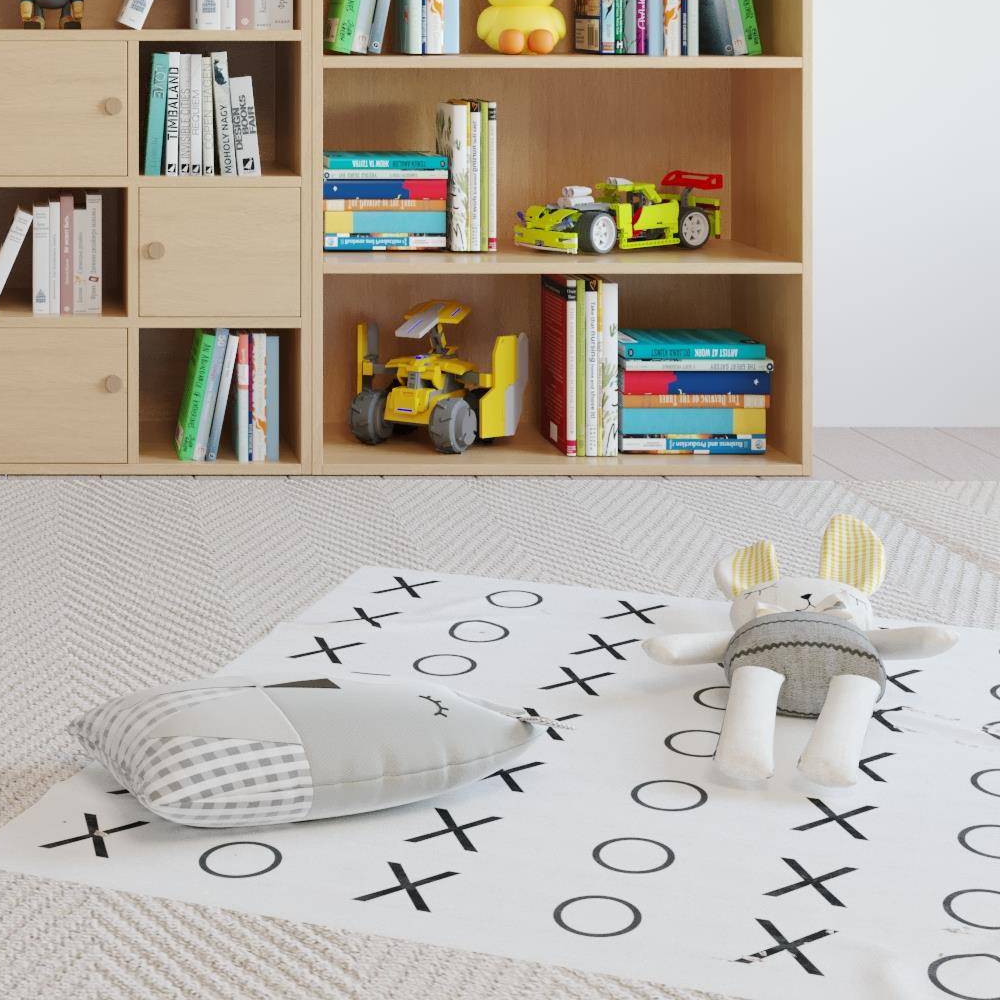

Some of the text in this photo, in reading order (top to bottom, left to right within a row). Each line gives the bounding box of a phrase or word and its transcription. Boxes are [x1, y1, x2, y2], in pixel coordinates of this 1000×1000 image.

[167, 67, 179, 141] TIMBALAND
[238, 94, 248, 135] BOOKS
[232, 107, 244, 151] DESIGN
[247, 106, 257, 134] FAIR
[220, 104, 232, 174] MOHOLY NAGY
[588, 330, 597, 363] nursing
[694, 348, 711, 357] WORK
[711, 348, 719, 357] AT
[719, 348, 739, 357] ARTIST
[675, 439, 743, 448] Business and Production
